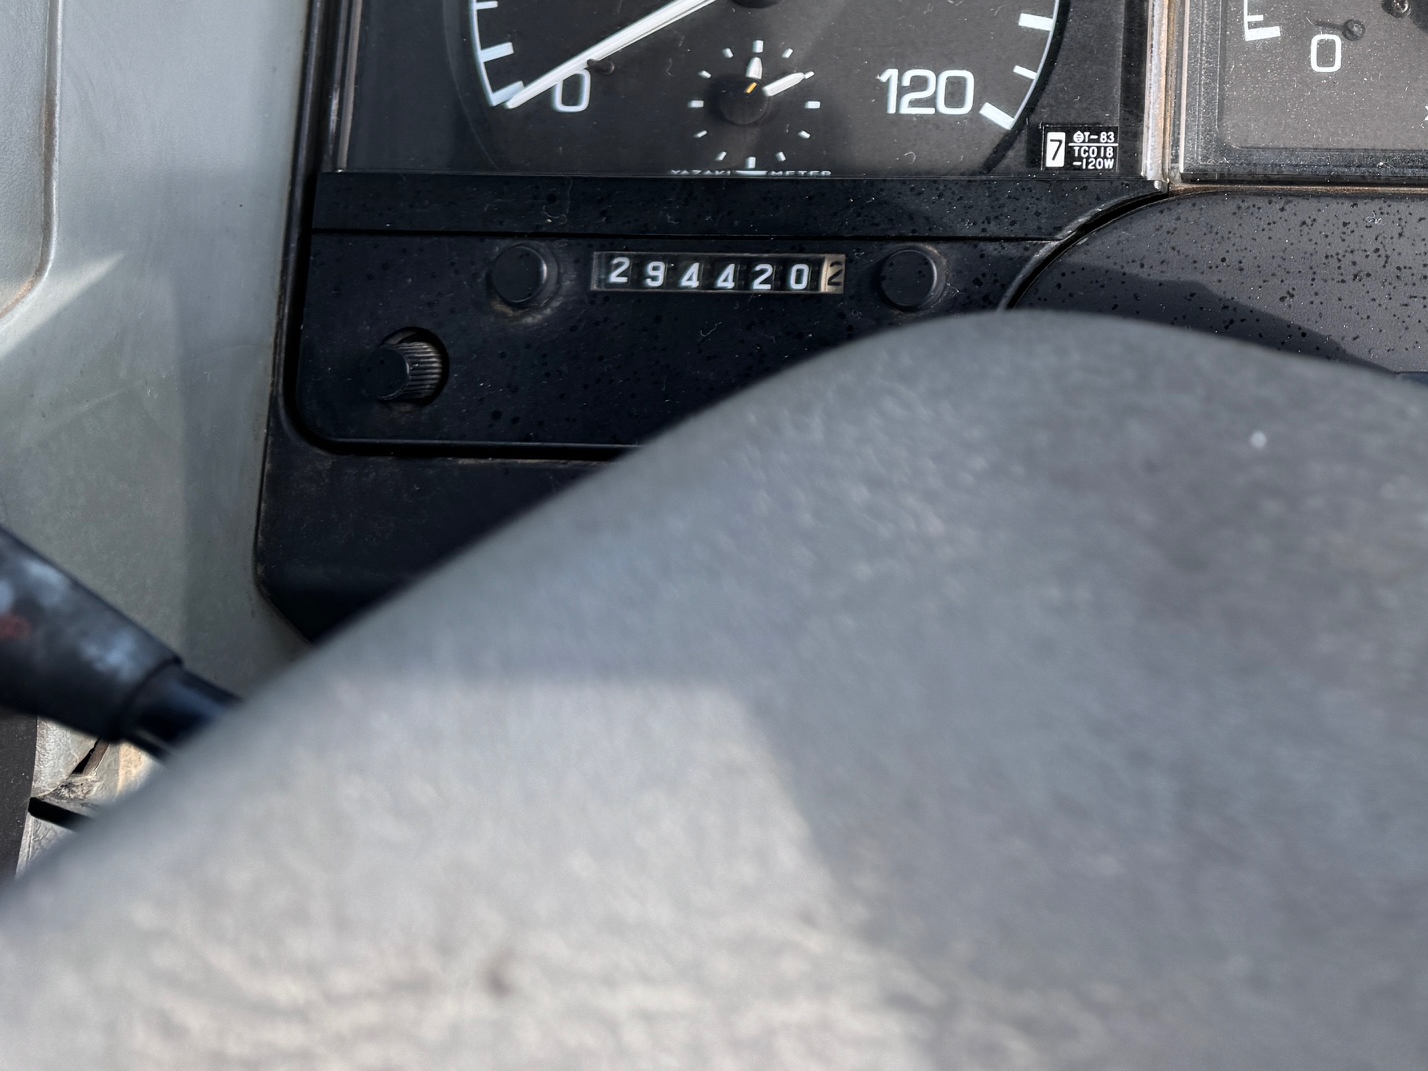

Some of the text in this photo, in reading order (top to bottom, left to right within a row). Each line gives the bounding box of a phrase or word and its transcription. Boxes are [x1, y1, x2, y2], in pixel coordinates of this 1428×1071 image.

[1310, 33, 1342, 74] 0
[552, 68, 591, 113] 0
[877, 69, 975, 116] 120
[1049, 138, 1063, 161] 7
[1073, 158, 1114, 169] -120W
